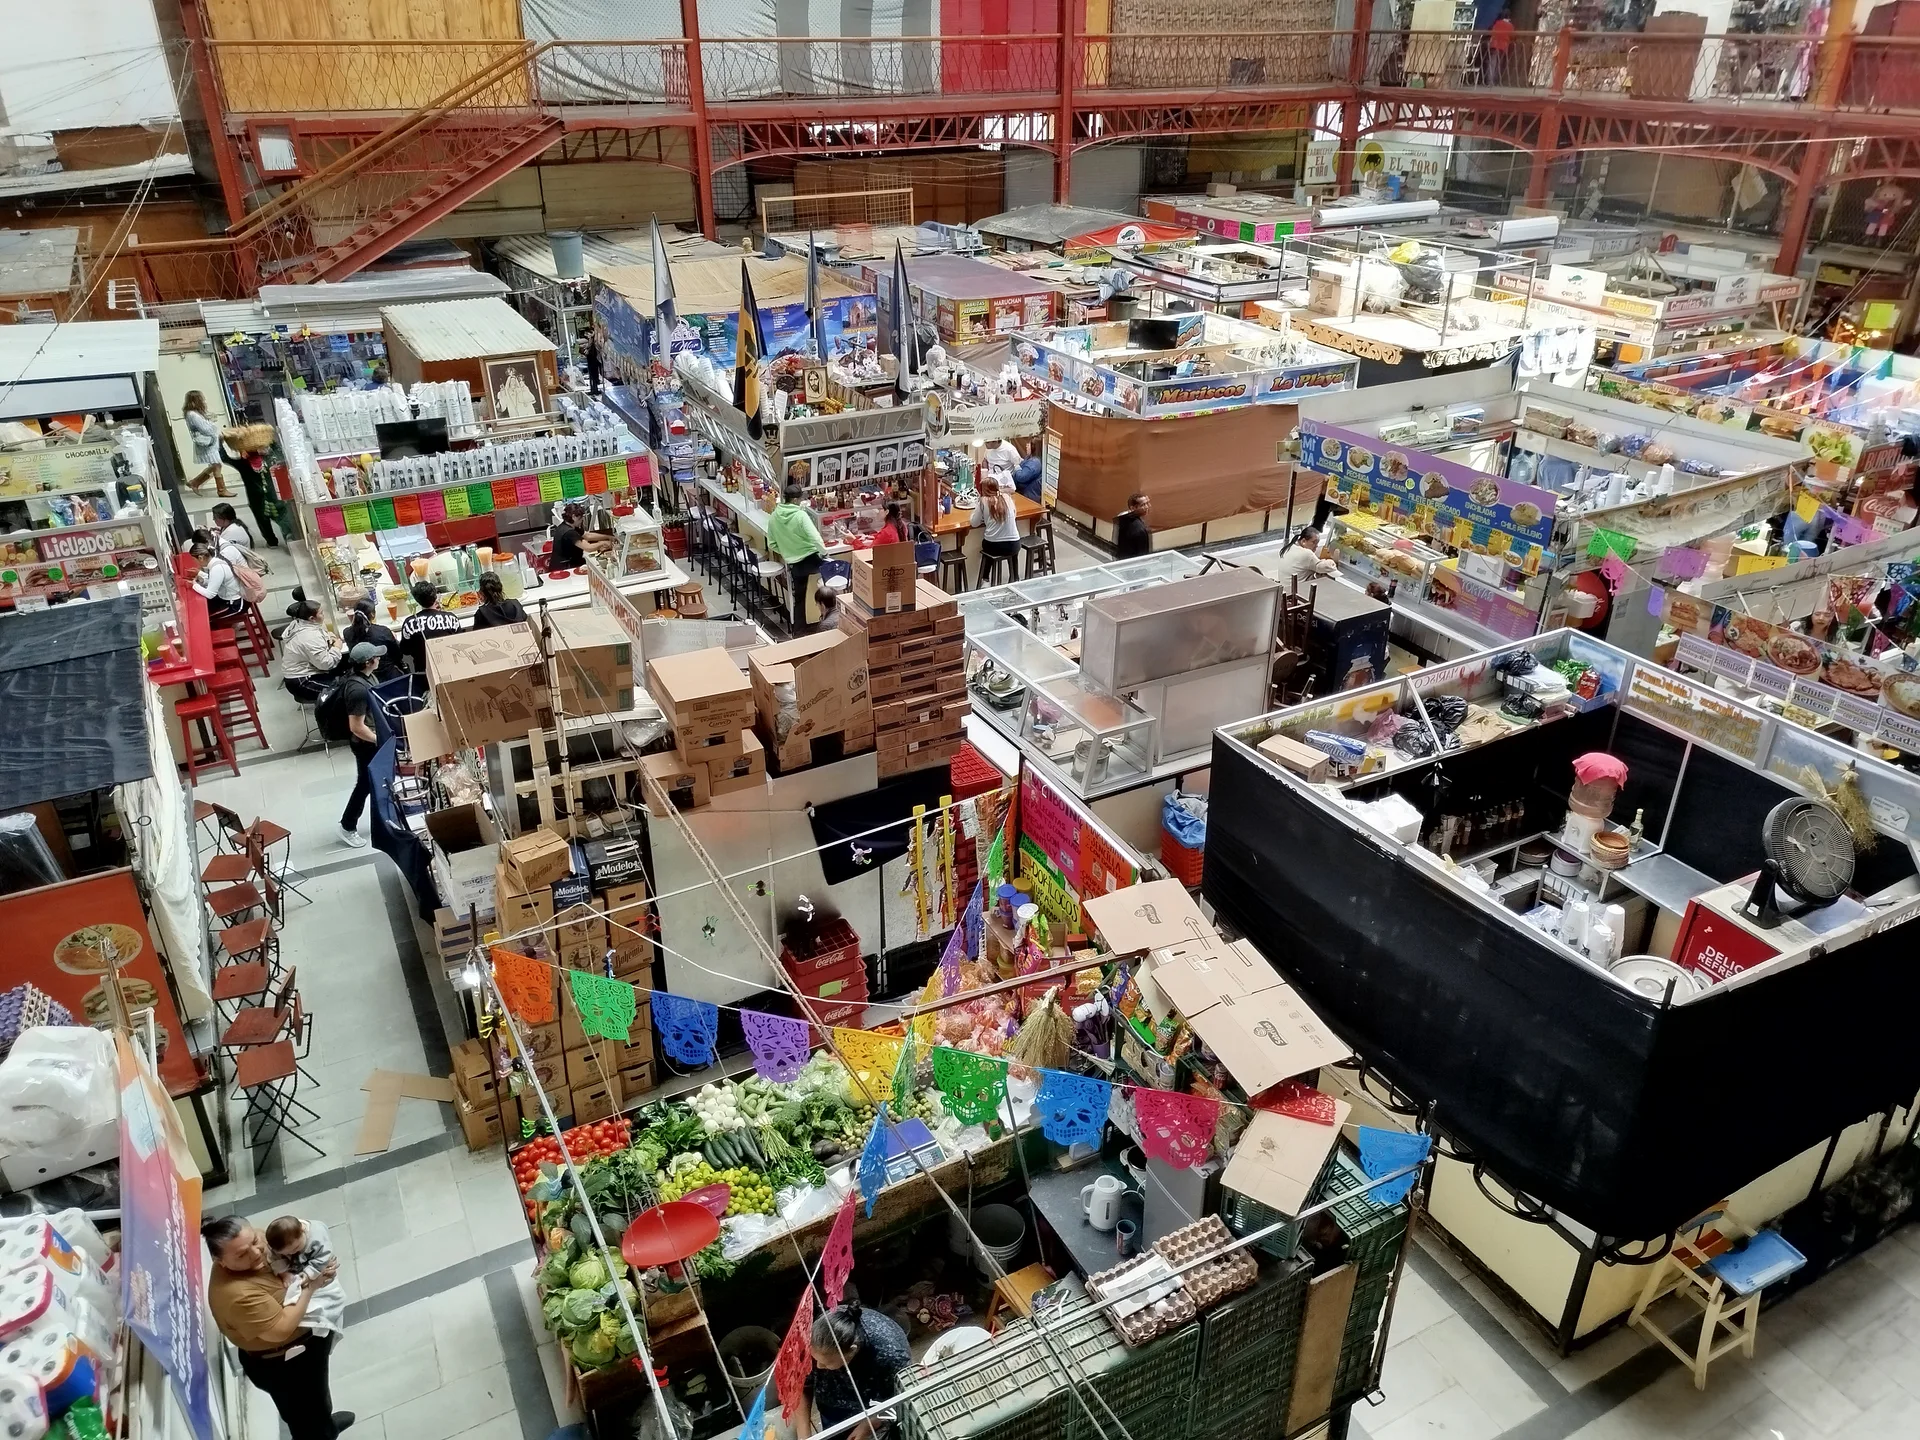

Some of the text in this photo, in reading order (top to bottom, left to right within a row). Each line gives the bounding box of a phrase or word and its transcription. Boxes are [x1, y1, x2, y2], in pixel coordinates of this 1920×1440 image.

[1315, 156, 1325, 166] EL
[1389, 156, 1438, 177] EL TORO
[1307, 165, 1328, 178] TORO
[1761, 285, 1797, 300] Manteca
[993, 297, 1022, 307] MARUCHAN
[1670, 297, 1704, 311] Carnitas
[1158, 370, 1345, 404] Mariscos La Playa
[971, 404, 1037, 427] Dulce vida
[796, 410, 913, 447] PUMAS
[1302, 420, 1318, 436] CO
[1302, 435, 1317, 451] MI
[907, 459, 918, 468] 70
[1301, 450, 1315, 467] DA
[851, 468, 863, 477] 140
[880, 463, 891, 473] 90
[1346, 469, 1369, 483] PECHUGA
[823, 474, 835, 483] 140
[1375, 477, 1409, 494] CARNE ASADA
[1408, 494, 1461, 517] FILETE DE PESCADO
[1464, 501, 1497, 519] ENCHILADAS
[1467, 512, 1491, 526] MINERAS
[1500, 520, 1517, 532] CHILE
[1516, 525, 1543, 540] RELLENO
[1461, 580, 1495, 602] TORTAS
[1296, 613, 1318, 628] Pesi
[1714, 655, 1749, 676] Enchiladas
[1753, 671, 1787, 691] Mineras
[1801, 685, 1827, 700] Chile
[1793, 693, 1830, 712] Relleno
[1885, 716, 1920, 736] Carne
[1881, 728, 1918, 749] Asada
[524, 861, 554, 889] Bohemia
[601, 861, 634, 877] Modelo
[558, 885, 583, 898] Modelo
[614, 943, 645, 968] Bohemia
[815, 950, 846, 969] Coca-Cola
[1704, 944, 1744, 975] DELIC
[824, 1004, 854, 1023] Coca-Cola
